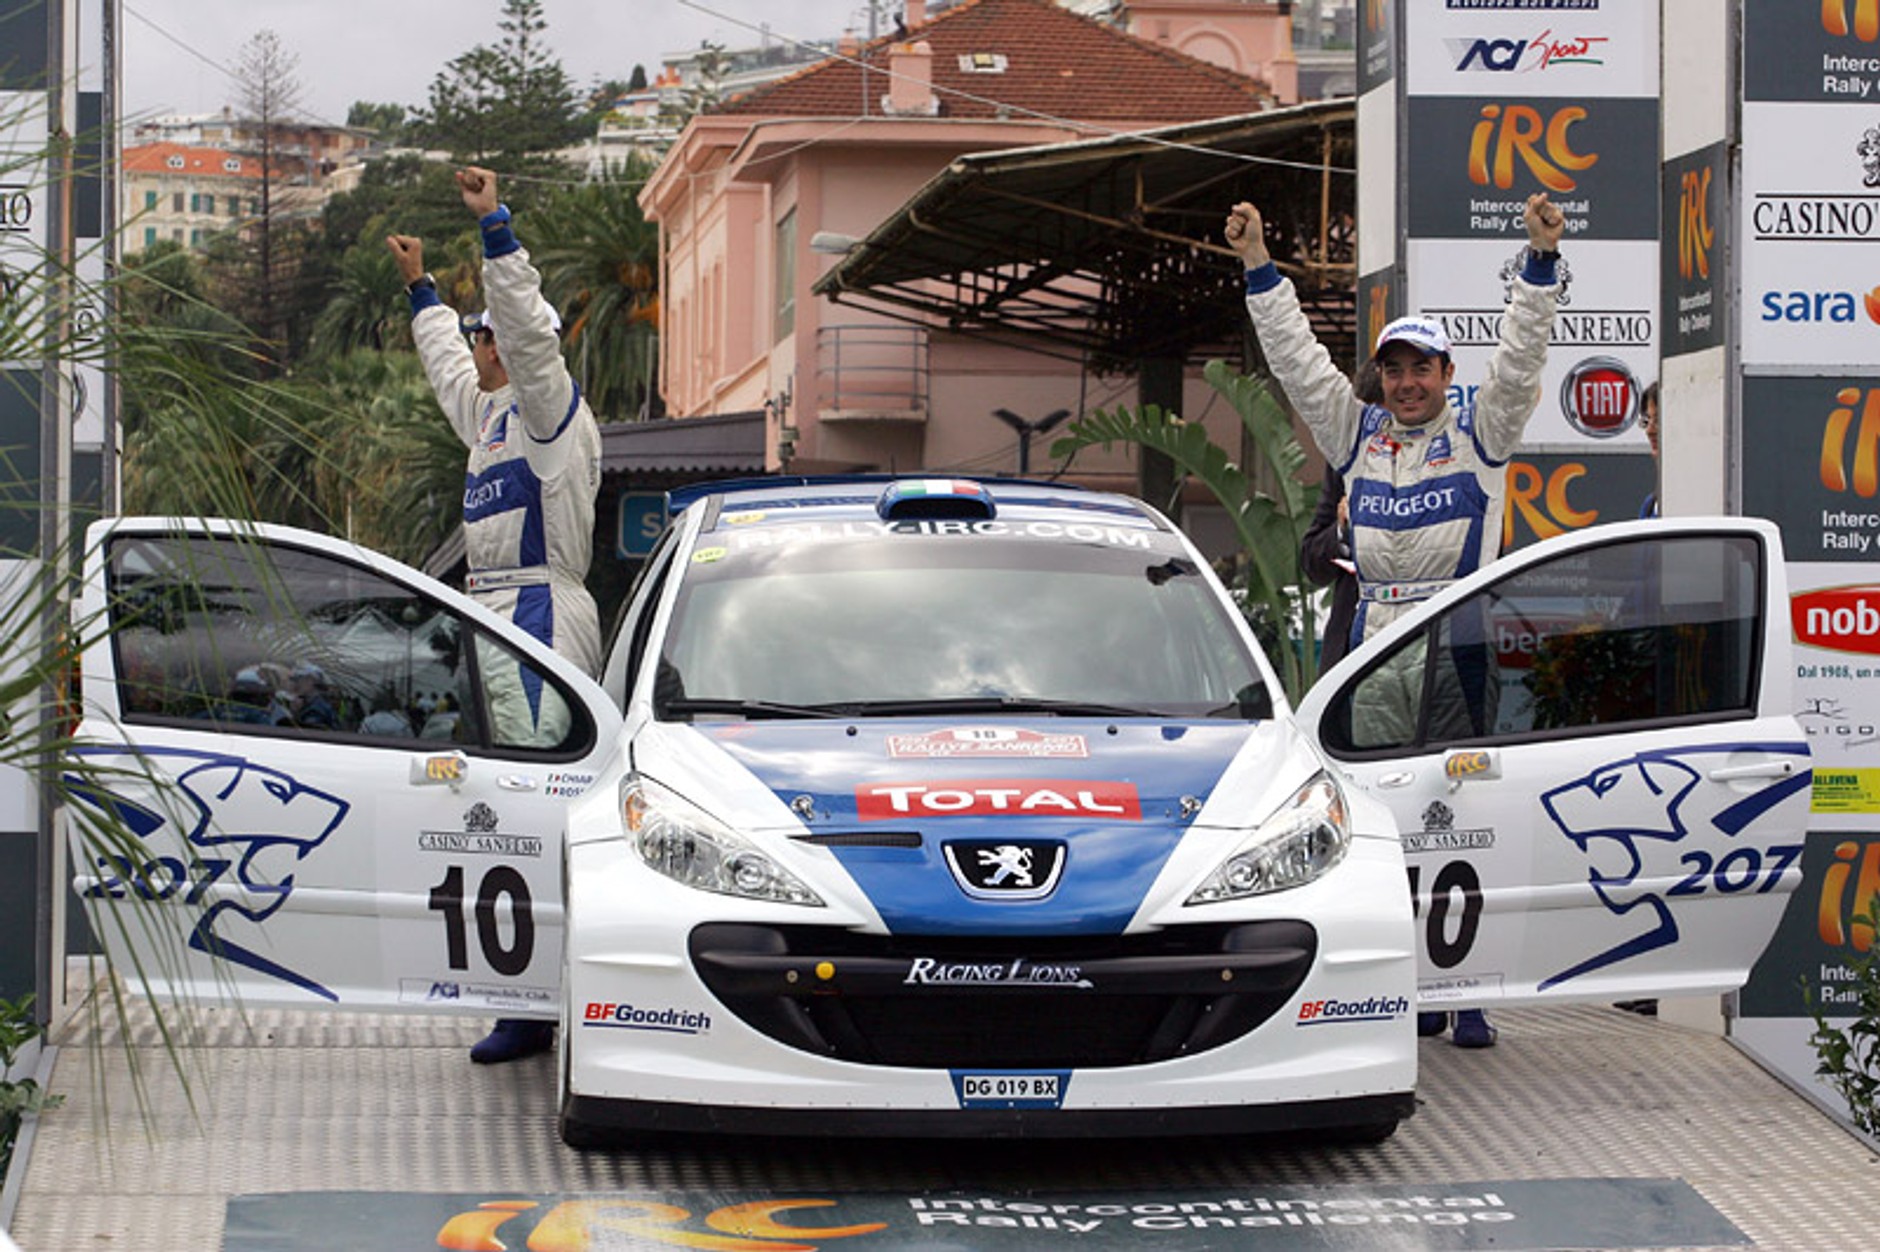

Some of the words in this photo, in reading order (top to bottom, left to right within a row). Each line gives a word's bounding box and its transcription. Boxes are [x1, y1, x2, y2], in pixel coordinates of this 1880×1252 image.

[1455, 39, 1528, 71] ACI
[1528, 29, 1609, 73] Sport
[1823, 75, 1872, 97] Rally
[1470, 216, 1509, 232] Rally
[1761, 291, 1856, 323] sara
[1581, 382, 1625, 416] FIAT
[1358, 488, 1455, 516] PEUGEOT
[1822, 532, 1871, 552] Rally
[872, 787, 1124, 814] TOTAL
[83, 855, 231, 904] 207
[1666, 844, 1805, 896] 207
[429, 866, 535, 977] 10
[903, 957, 1003, 984] RACING
[1006, 958, 1081, 983] LIONS
[584, 1002, 712, 1029] BFGoodrich
[1298, 996, 1409, 1019] BFGoodrich
[965, 1079, 991, 1096] DG
[996, 1079, 1029, 1096] 019
[1033, 1079, 1057, 1095] BX
[915, 1211, 1102, 1232] Rally
[1132, 1210, 1516, 1229] Challenge
